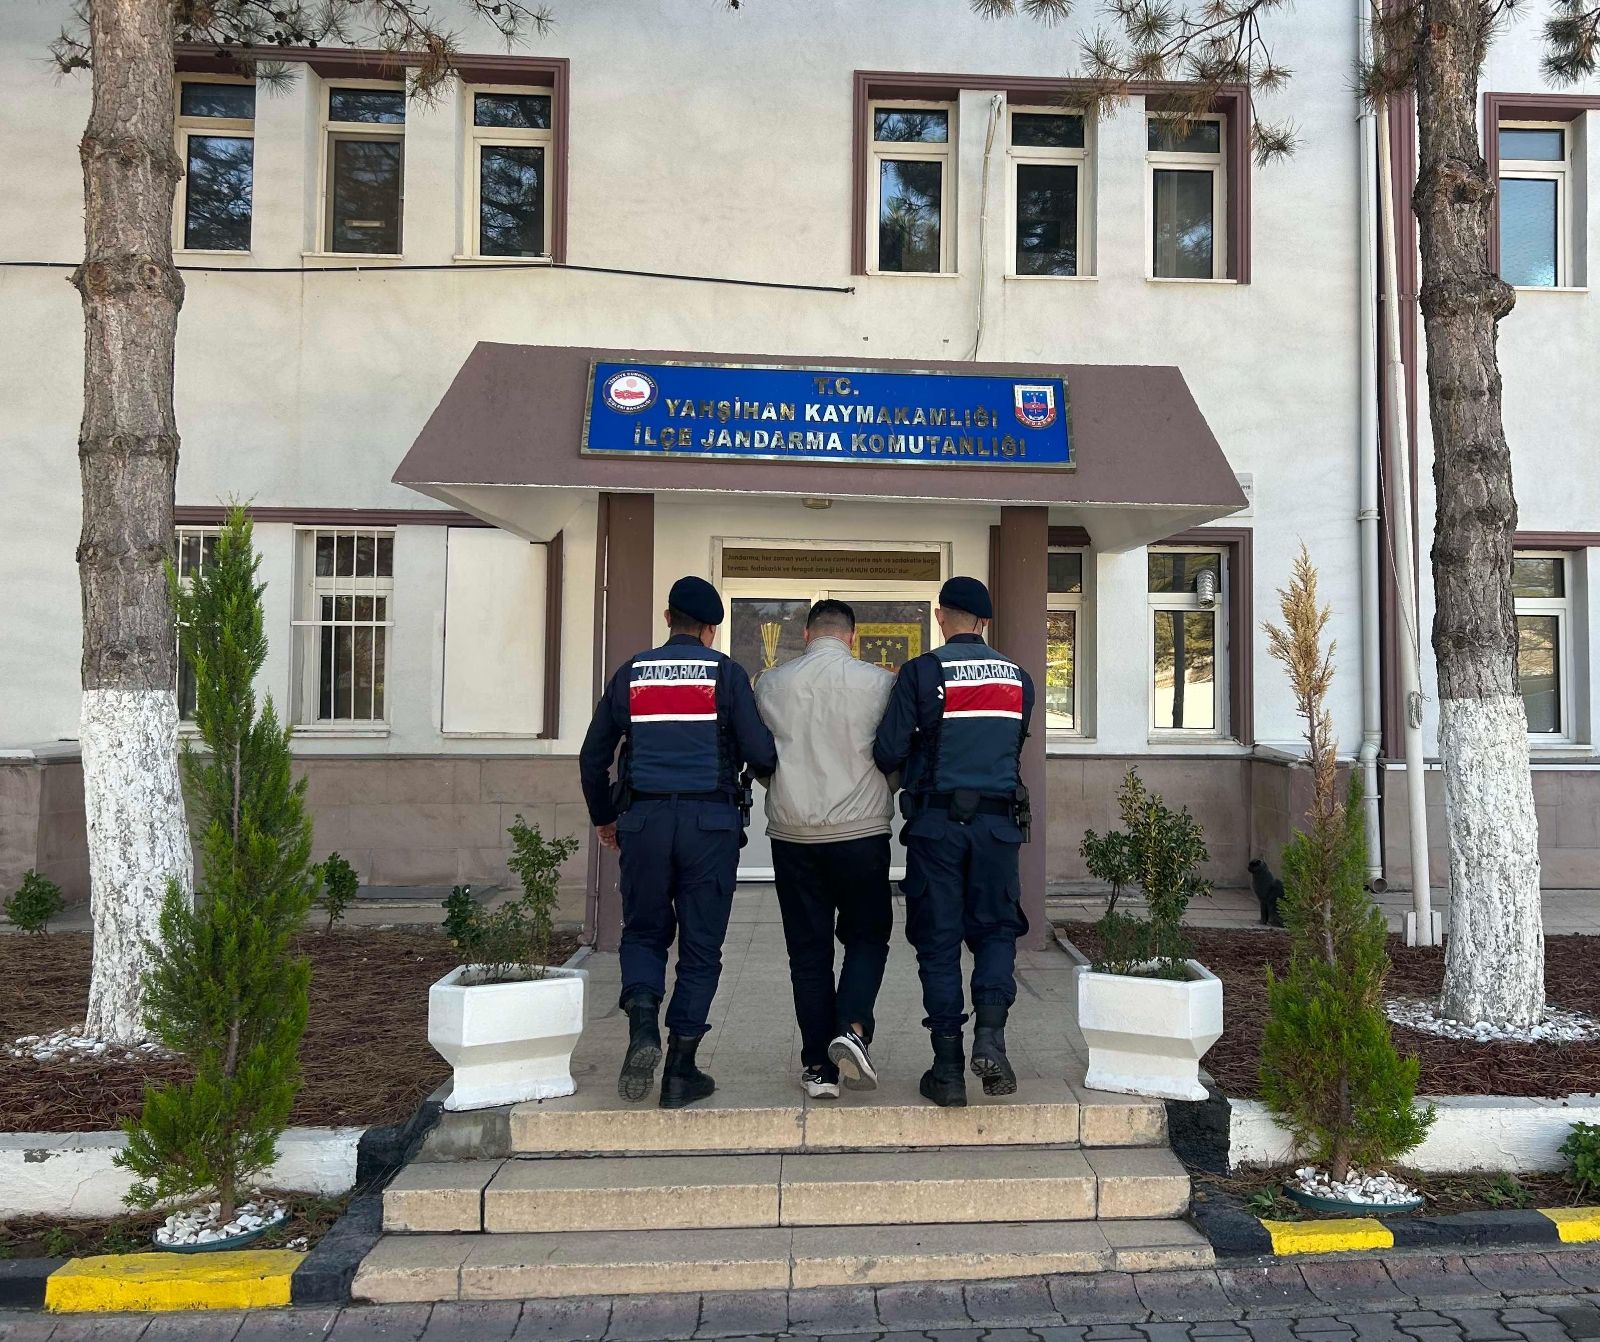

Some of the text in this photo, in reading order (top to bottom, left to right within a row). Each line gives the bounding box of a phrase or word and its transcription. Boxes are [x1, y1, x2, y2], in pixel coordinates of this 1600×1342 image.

[814, 377, 859, 396] T.C.
[665, 397, 998, 429] YAHŞİHAN KAYMAKAMLIĞI
[634, 421, 1026, 457] İLÇE JANDARMA KOMUTANLIĞI
[638, 665, 708, 680] JANDARMA
[953, 664, 1017, 680] JANDARMA
